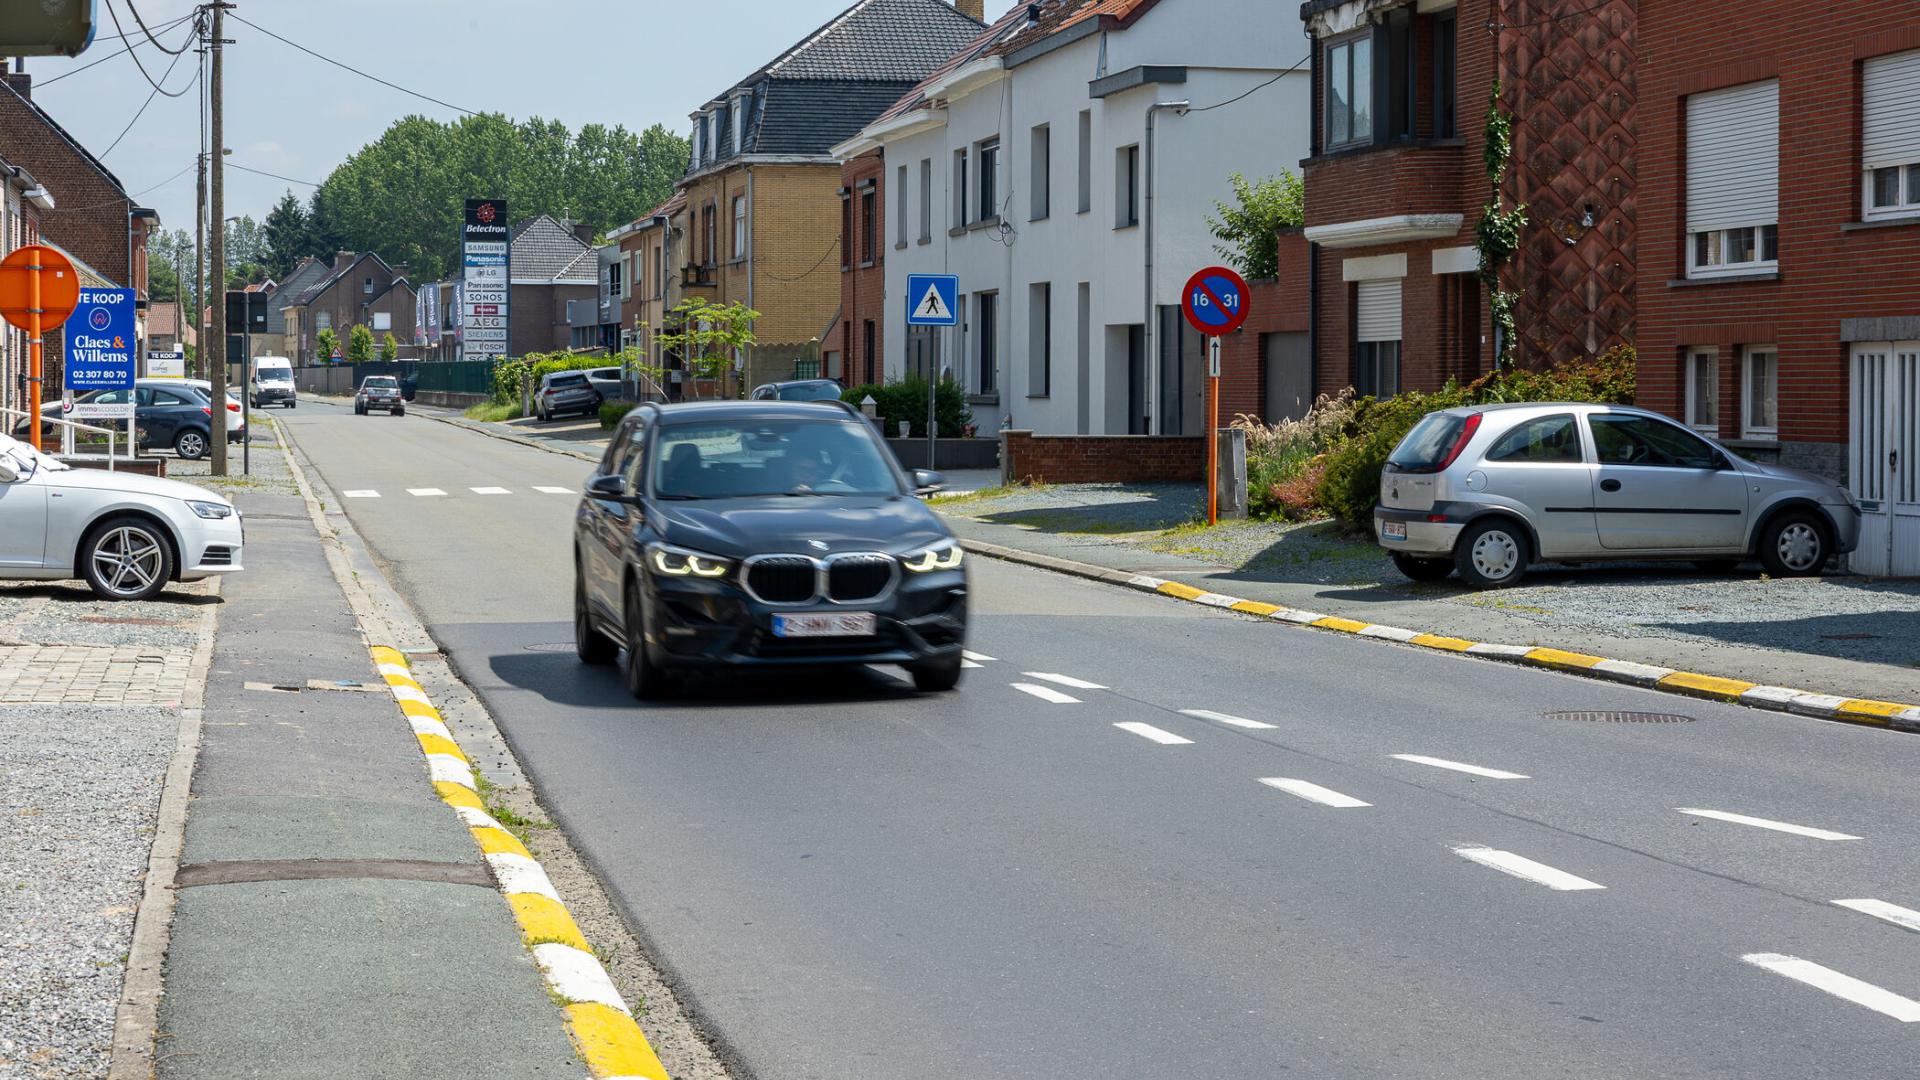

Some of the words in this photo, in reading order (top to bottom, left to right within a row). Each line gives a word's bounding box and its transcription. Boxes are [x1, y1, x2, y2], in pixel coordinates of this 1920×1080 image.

[466, 224, 506, 233] Belectron
[467, 244, 505, 252] SAMSUNG
[466, 255, 506, 263] Panasonic
[486, 269, 497, 277] LG
[467, 281, 504, 289] Panasonic
[78, 292, 90, 304] TE
[93, 292, 125, 304] KOOP
[469, 293, 503, 302] SONOS
[1193, 292, 1209, 307] 16
[1223, 293, 1239, 308] 31
[473, 317, 500, 327] AEG
[467, 330, 504, 338] SIEMENS
[75, 335, 111, 349] Claes
[113, 335, 125, 349] &
[73, 349, 128, 363] Willems
[73, 370, 84, 379] 02
[86, 370, 101, 379] 307
[103, 370, 115, 379] 80
[116, 370, 127, 379] 70
